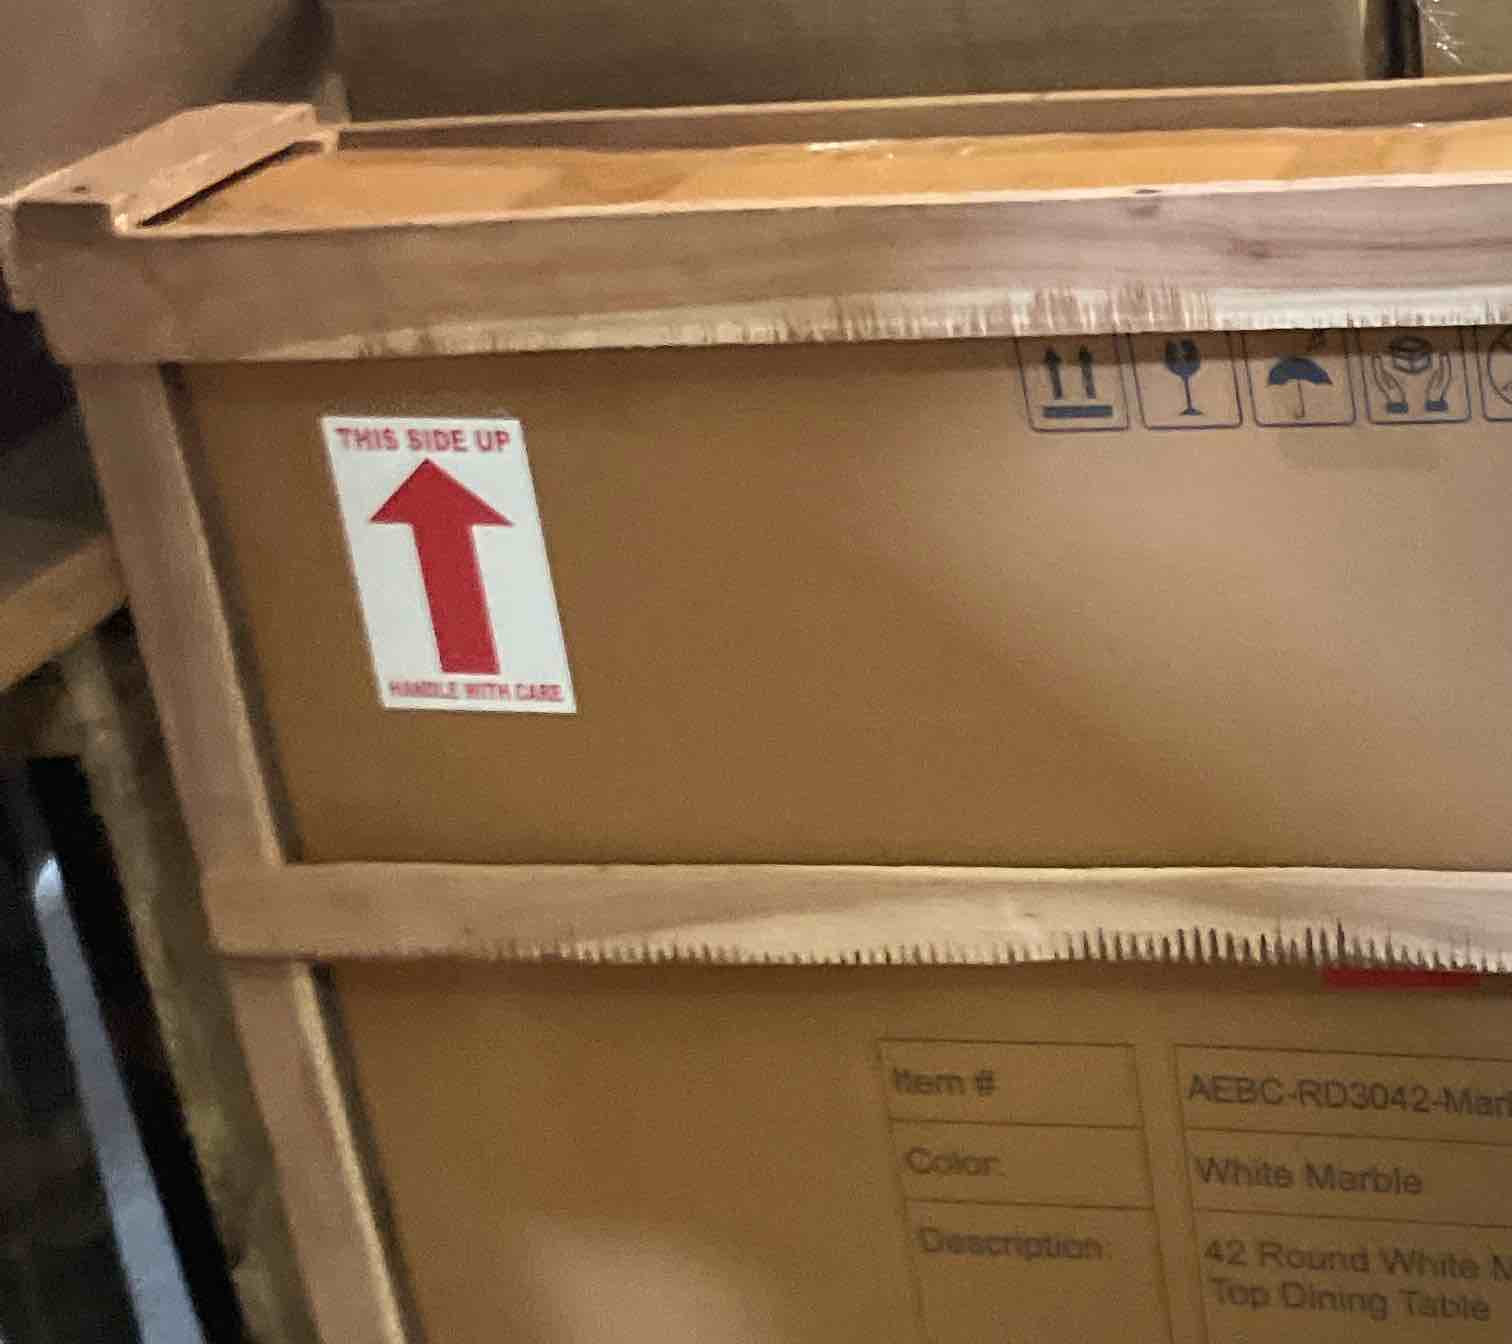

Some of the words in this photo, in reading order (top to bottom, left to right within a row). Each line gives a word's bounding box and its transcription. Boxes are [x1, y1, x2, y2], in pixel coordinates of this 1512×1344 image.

[335, 427, 398, 452] THIS
[407, 427, 468, 453] SIDE
[476, 429, 512, 453] UP
[388, 680, 459, 700] HANDLE
[464, 683, 511, 701] WITH
[892, 1066, 965, 1096] Item
[974, 1069, 996, 1097] #
[904, 1146, 1001, 1177] Color
[1196, 1157, 1295, 1189] White
[1305, 1162, 1424, 1196] Marble
[915, 1225, 1104, 1261] Description
[1203, 1238, 1249, 1267] 42
[1257, 1240, 1371, 1274] Round
[1380, 1247, 1481, 1282] White
[1209, 1276, 1271, 1310] Top
[1280, 1280, 1389, 1322] Dining
[1399, 1289, 1491, 1322] Table
